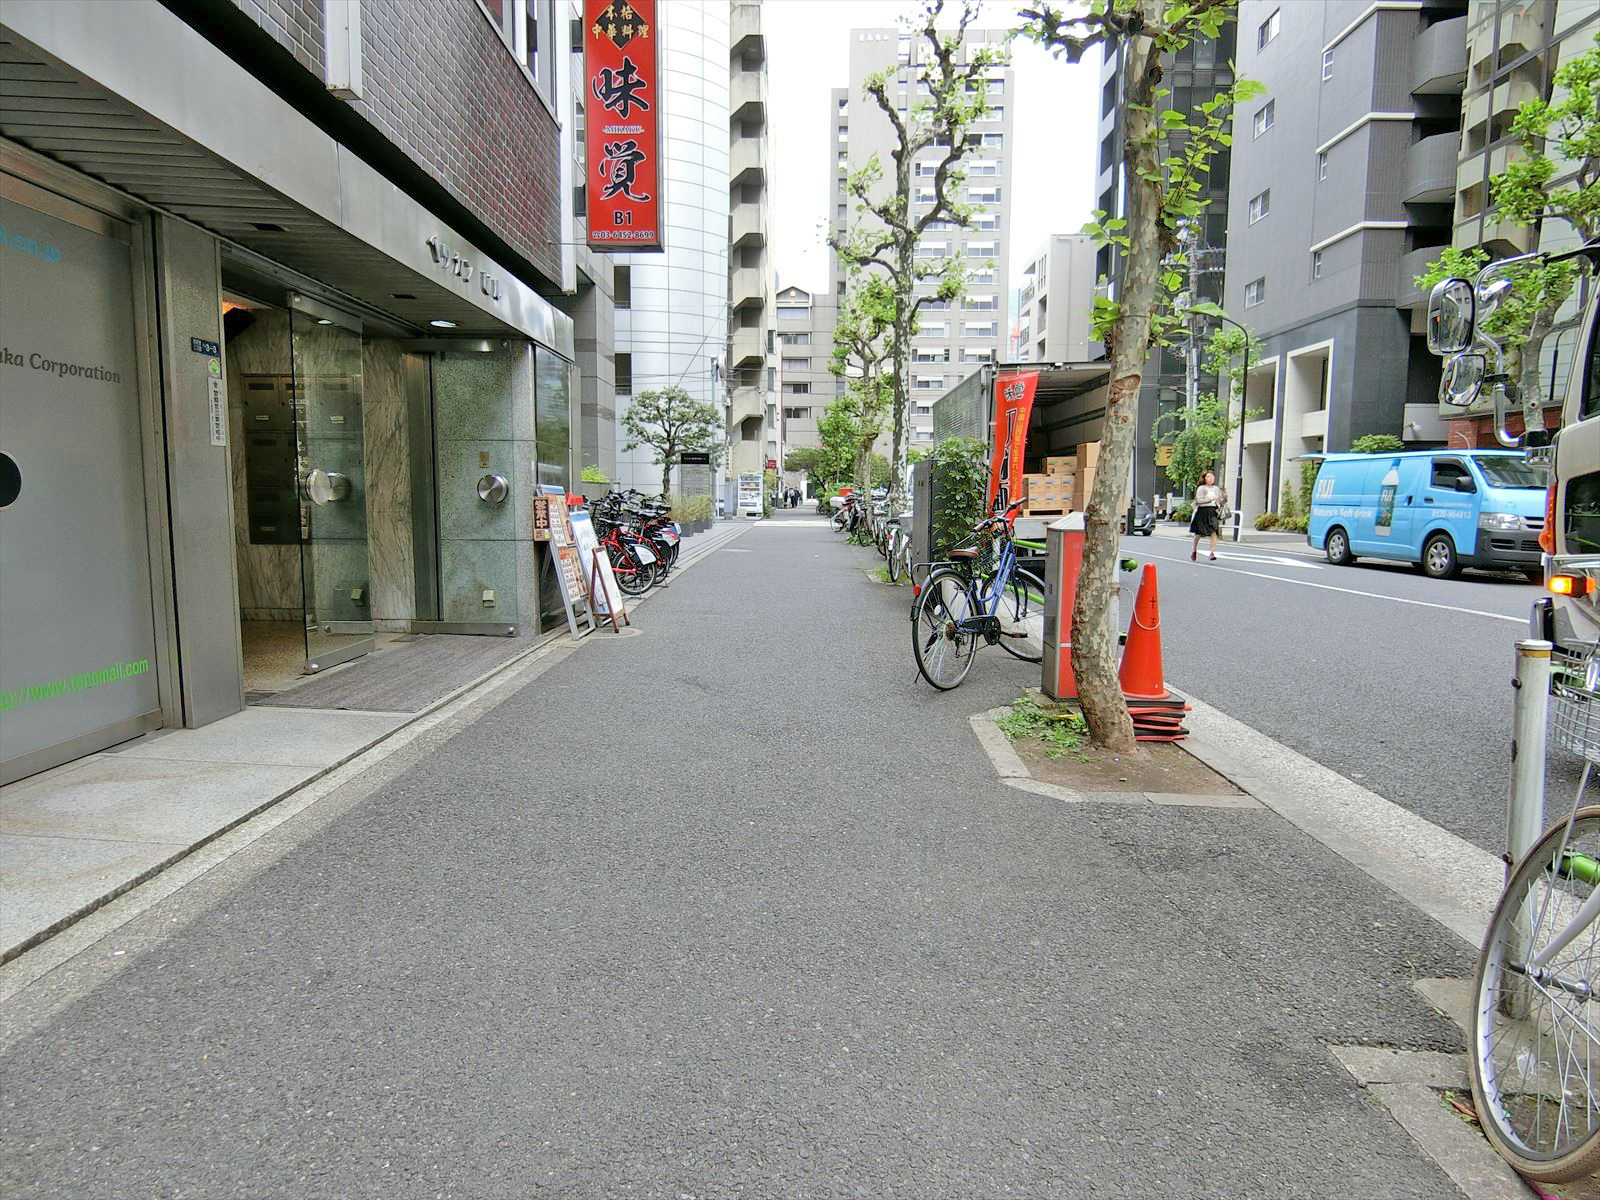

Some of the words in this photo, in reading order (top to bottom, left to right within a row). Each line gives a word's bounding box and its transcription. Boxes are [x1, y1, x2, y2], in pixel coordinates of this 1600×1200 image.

[591, 23, 650, 40] 中華料理
[613, 210, 633, 226] B1
[0, 347, 25, 367] ka
[29, 353, 121, 383] Corporation
